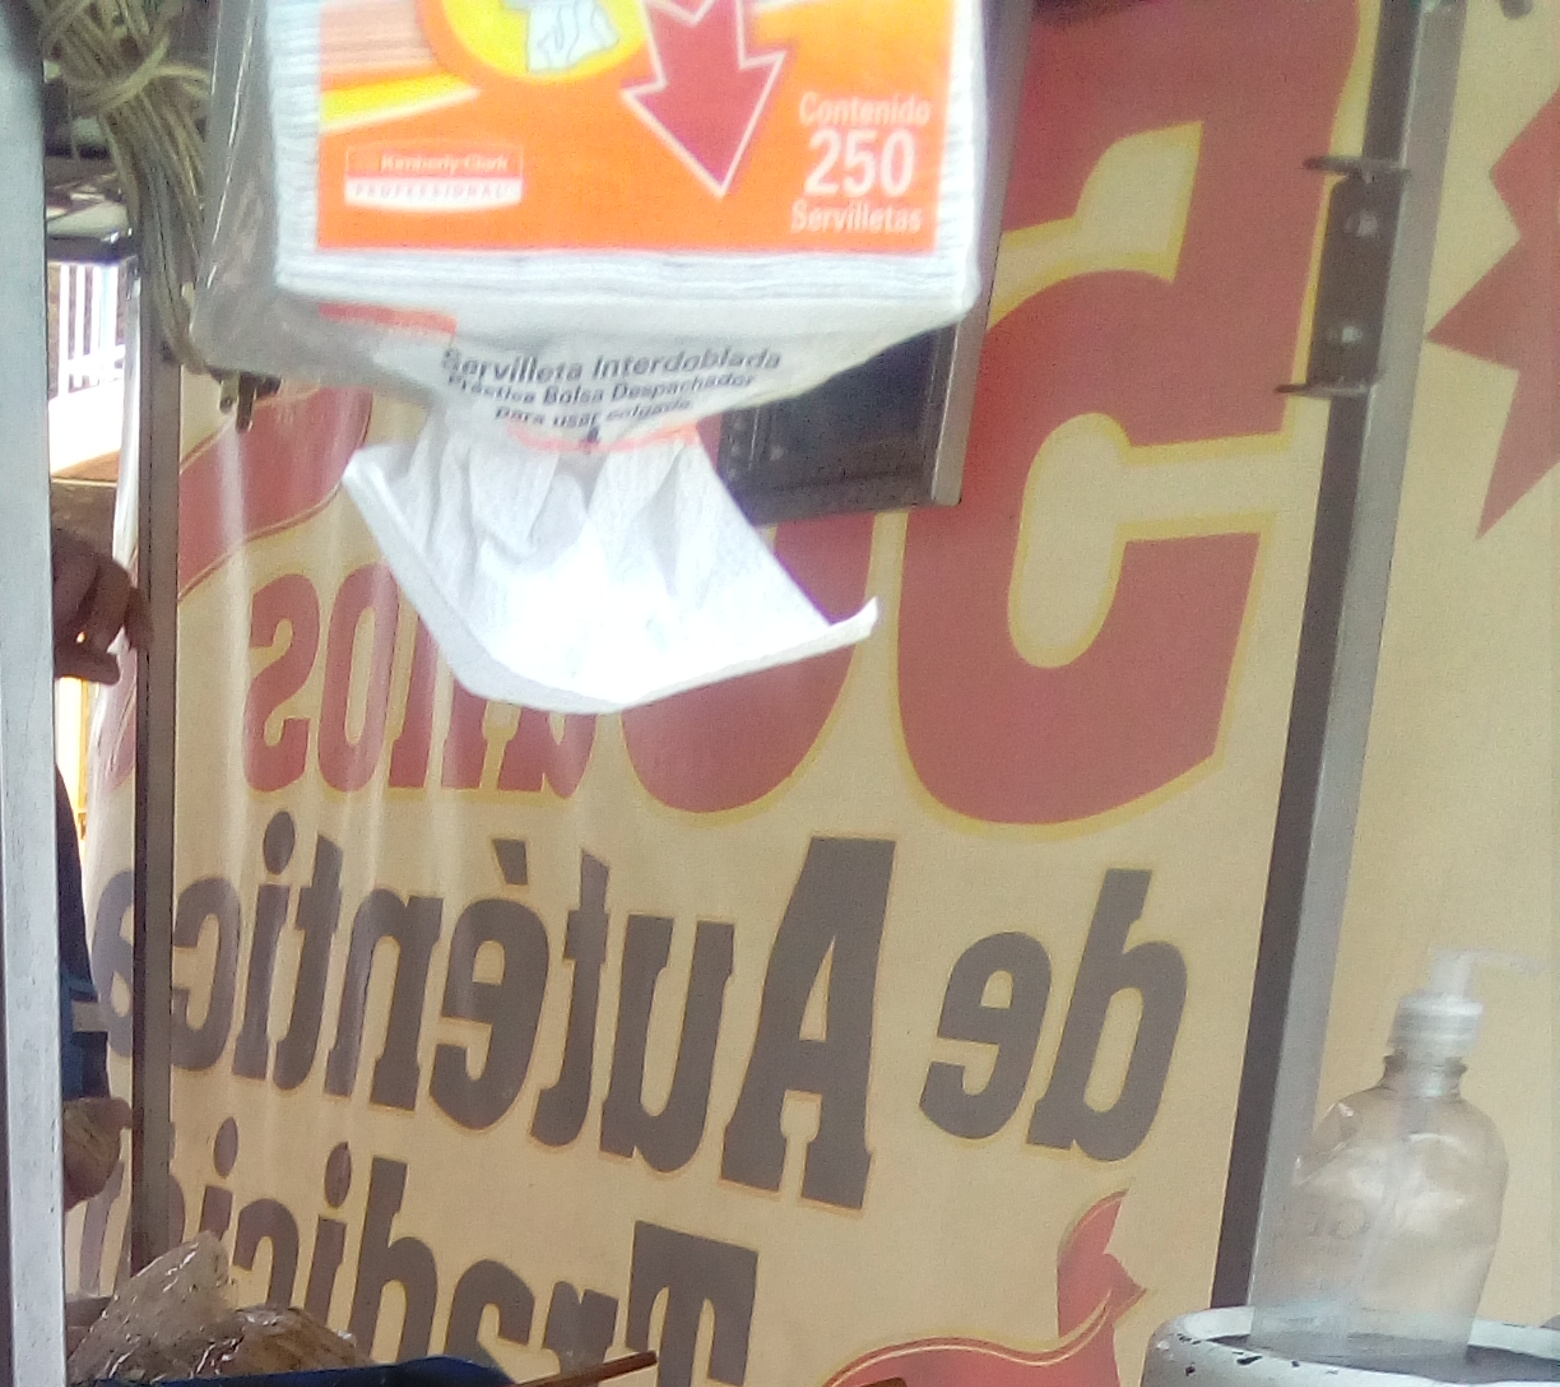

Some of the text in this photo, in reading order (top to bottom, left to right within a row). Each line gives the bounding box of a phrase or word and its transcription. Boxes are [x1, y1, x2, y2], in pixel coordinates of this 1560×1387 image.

[799, 91, 931, 127] Contenido
[804, 127, 916, 199] 250
[791, 199, 922, 233] Servilletas
[442, 347, 782, 384] Servilleta Interdoblada
[542, 380, 604, 406] Bolsa
[611, 371, 756, 403] Despachador
[496, 404, 547, 427] para
[553, 411, 602, 430] usar
